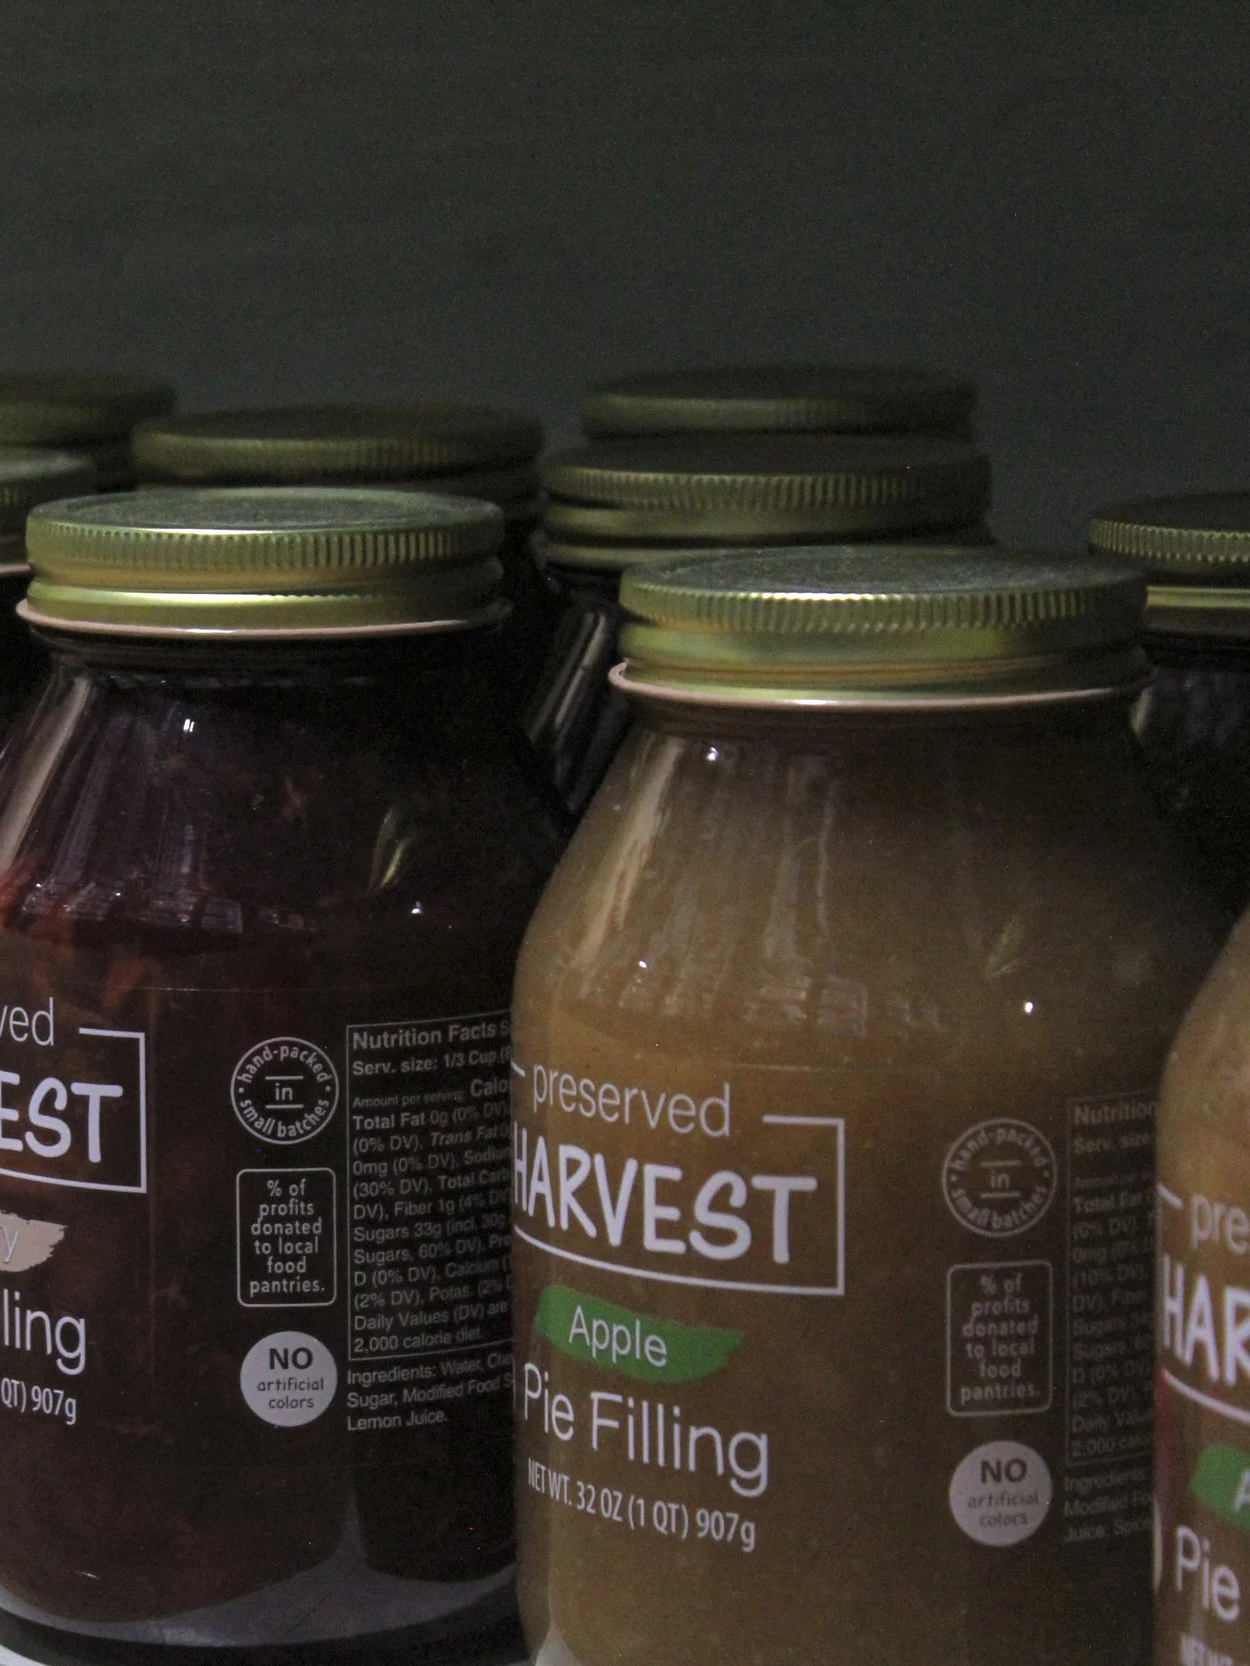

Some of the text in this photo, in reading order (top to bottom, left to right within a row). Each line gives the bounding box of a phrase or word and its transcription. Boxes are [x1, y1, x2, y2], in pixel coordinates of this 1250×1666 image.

[352, 1028, 442, 1050] Nutrition
[448, 1022, 497, 1043] Facts
[235, 1044, 332, 1084] hand-packed
[352, 1060, 397, 1077] Serv.
[400, 1057, 439, 1073] size:
[443, 1053, 466, 1070] 1/3
[274, 1082, 293, 1101] in
[533, 1064, 731, 1137] preserved
[238, 1097, 330, 1138] small batches
[352, 1114, 396, 1131] Total
[400, 1112, 426, 1128] Fat
[352, 1160, 389, 1178] 0mg
[989, 1170, 1010, 1189] in
[266, 1178, 307, 1197] % of
[513, 1121, 818, 1265] HARVEST
[258, 1197, 315, 1221] profits
[394, 1200, 433, 1216] Fiber
[250, 1217, 323, 1236] donated
[353, 1226, 410, 1245] Sugars
[253, 1236, 320, 1255] to local
[266, 1255, 307, 1275] food
[249, 1277, 326, 1298] pantries.
[353, 1271, 367, 1287] D
[354, 1314, 394, 1333] Daily
[398, 1309, 450, 1328] Values
[568, 1304, 668, 1367] Apple
[268, 1347, 314, 1370] NO
[256, 1376, 325, 1394] artificial
[346, 1366, 437, 1388] Ingredients:
[30, 1385, 78, 1427] 907g
[267, 1394, 315, 1410] colors
[346, 1413, 402, 1432] Lemon
[523, 1362, 769, 1497] Pie Filling
[979, 1458, 1029, 1484] NO
[528, 1457, 547, 1496] NET
[575, 1480, 597, 1515] 32
[600, 1487, 623, 1523] OZ
[628, 1495, 646, 1531] (1
[652, 1503, 690, 1541] QT)
[695, 1508, 756, 1553] 907g
[1176, 1525, 1241, 1624] Pie
